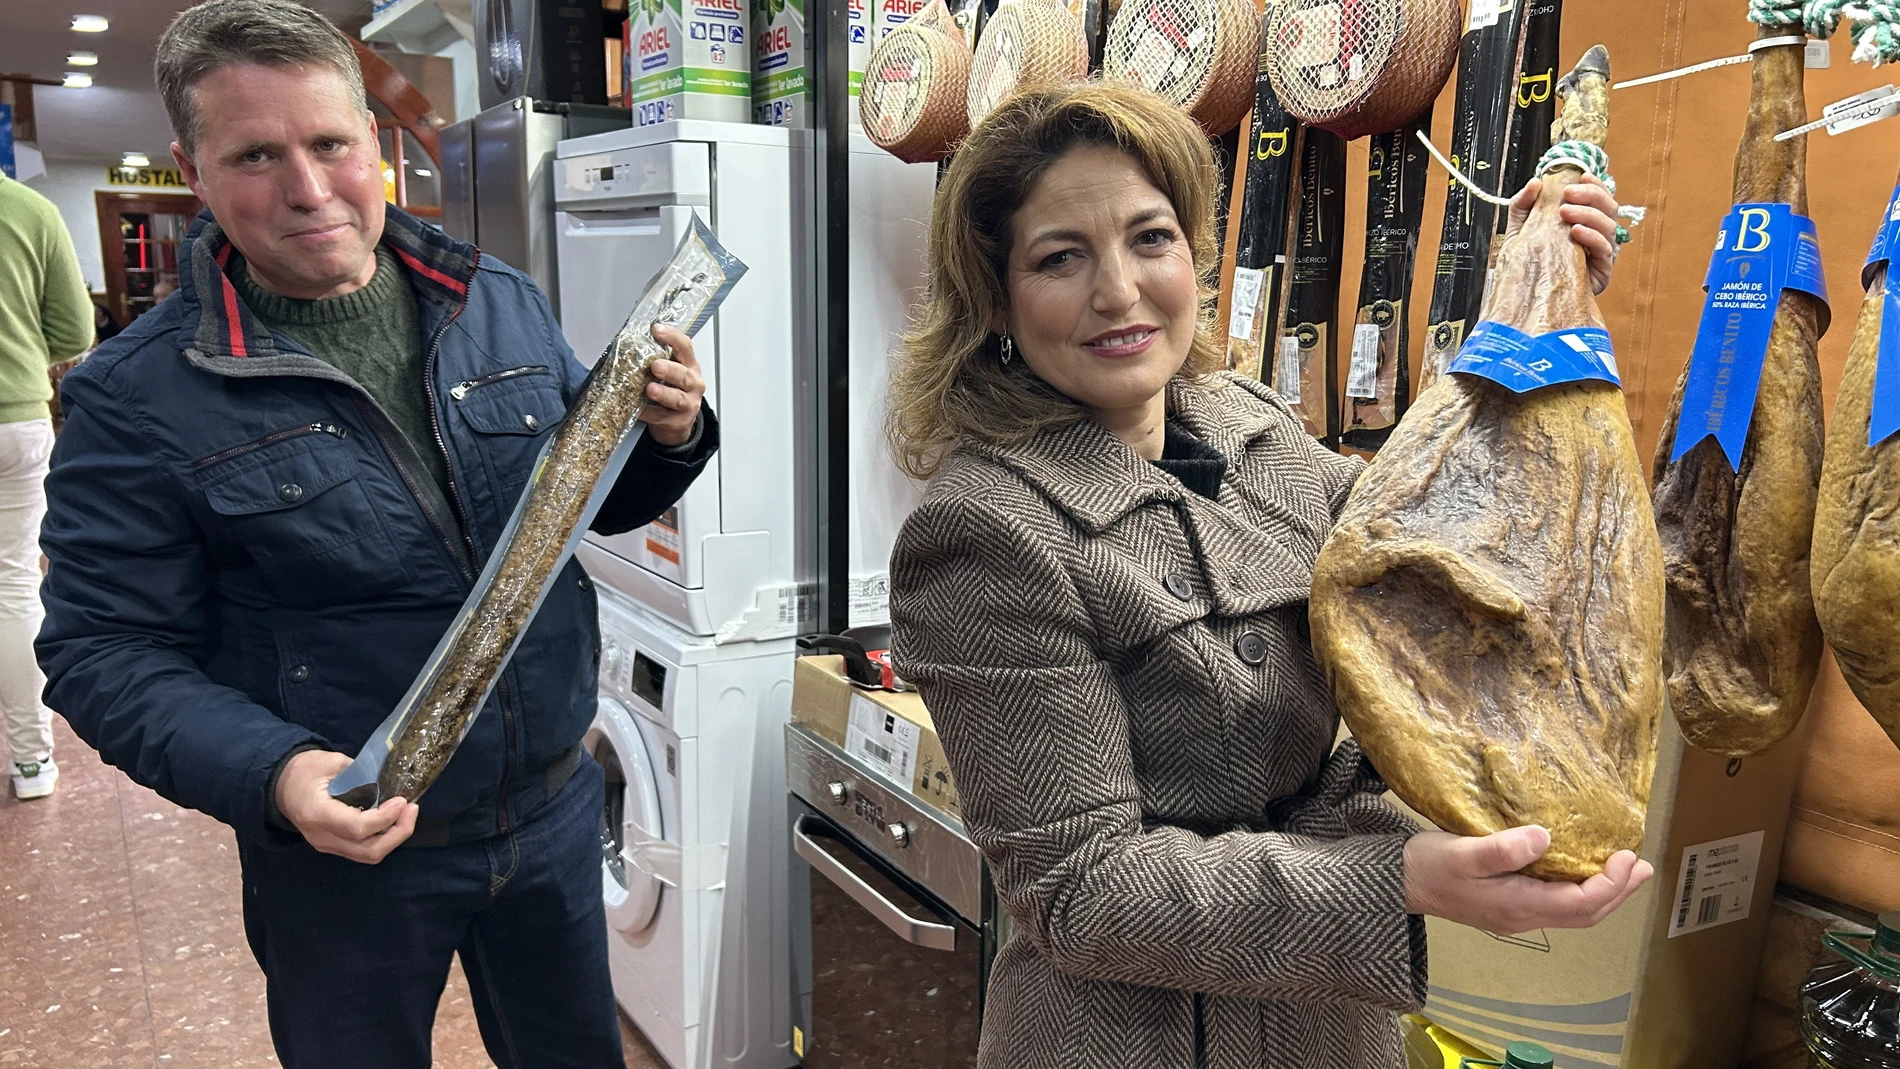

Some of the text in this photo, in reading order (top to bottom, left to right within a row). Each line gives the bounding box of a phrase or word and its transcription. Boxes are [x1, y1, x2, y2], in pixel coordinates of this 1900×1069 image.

[639, 26, 671, 57] ARIEL
[756, 26, 792, 57] ARIEL
[1517, 67, 1553, 108] B
[1257, 127, 1290, 160] B
[110, 166, 187, 185] HOSTAL
[1732, 207, 1771, 252] B
[1714, 291, 1767, 301] CEBO IBÉRICO
[1722, 281, 1749, 290] JAMÓN
[1741, 301, 1766, 309] IBÉRICA
[1527, 358, 1553, 372] B
[1705, 312, 1742, 432] IBÉRICOS BENITO
